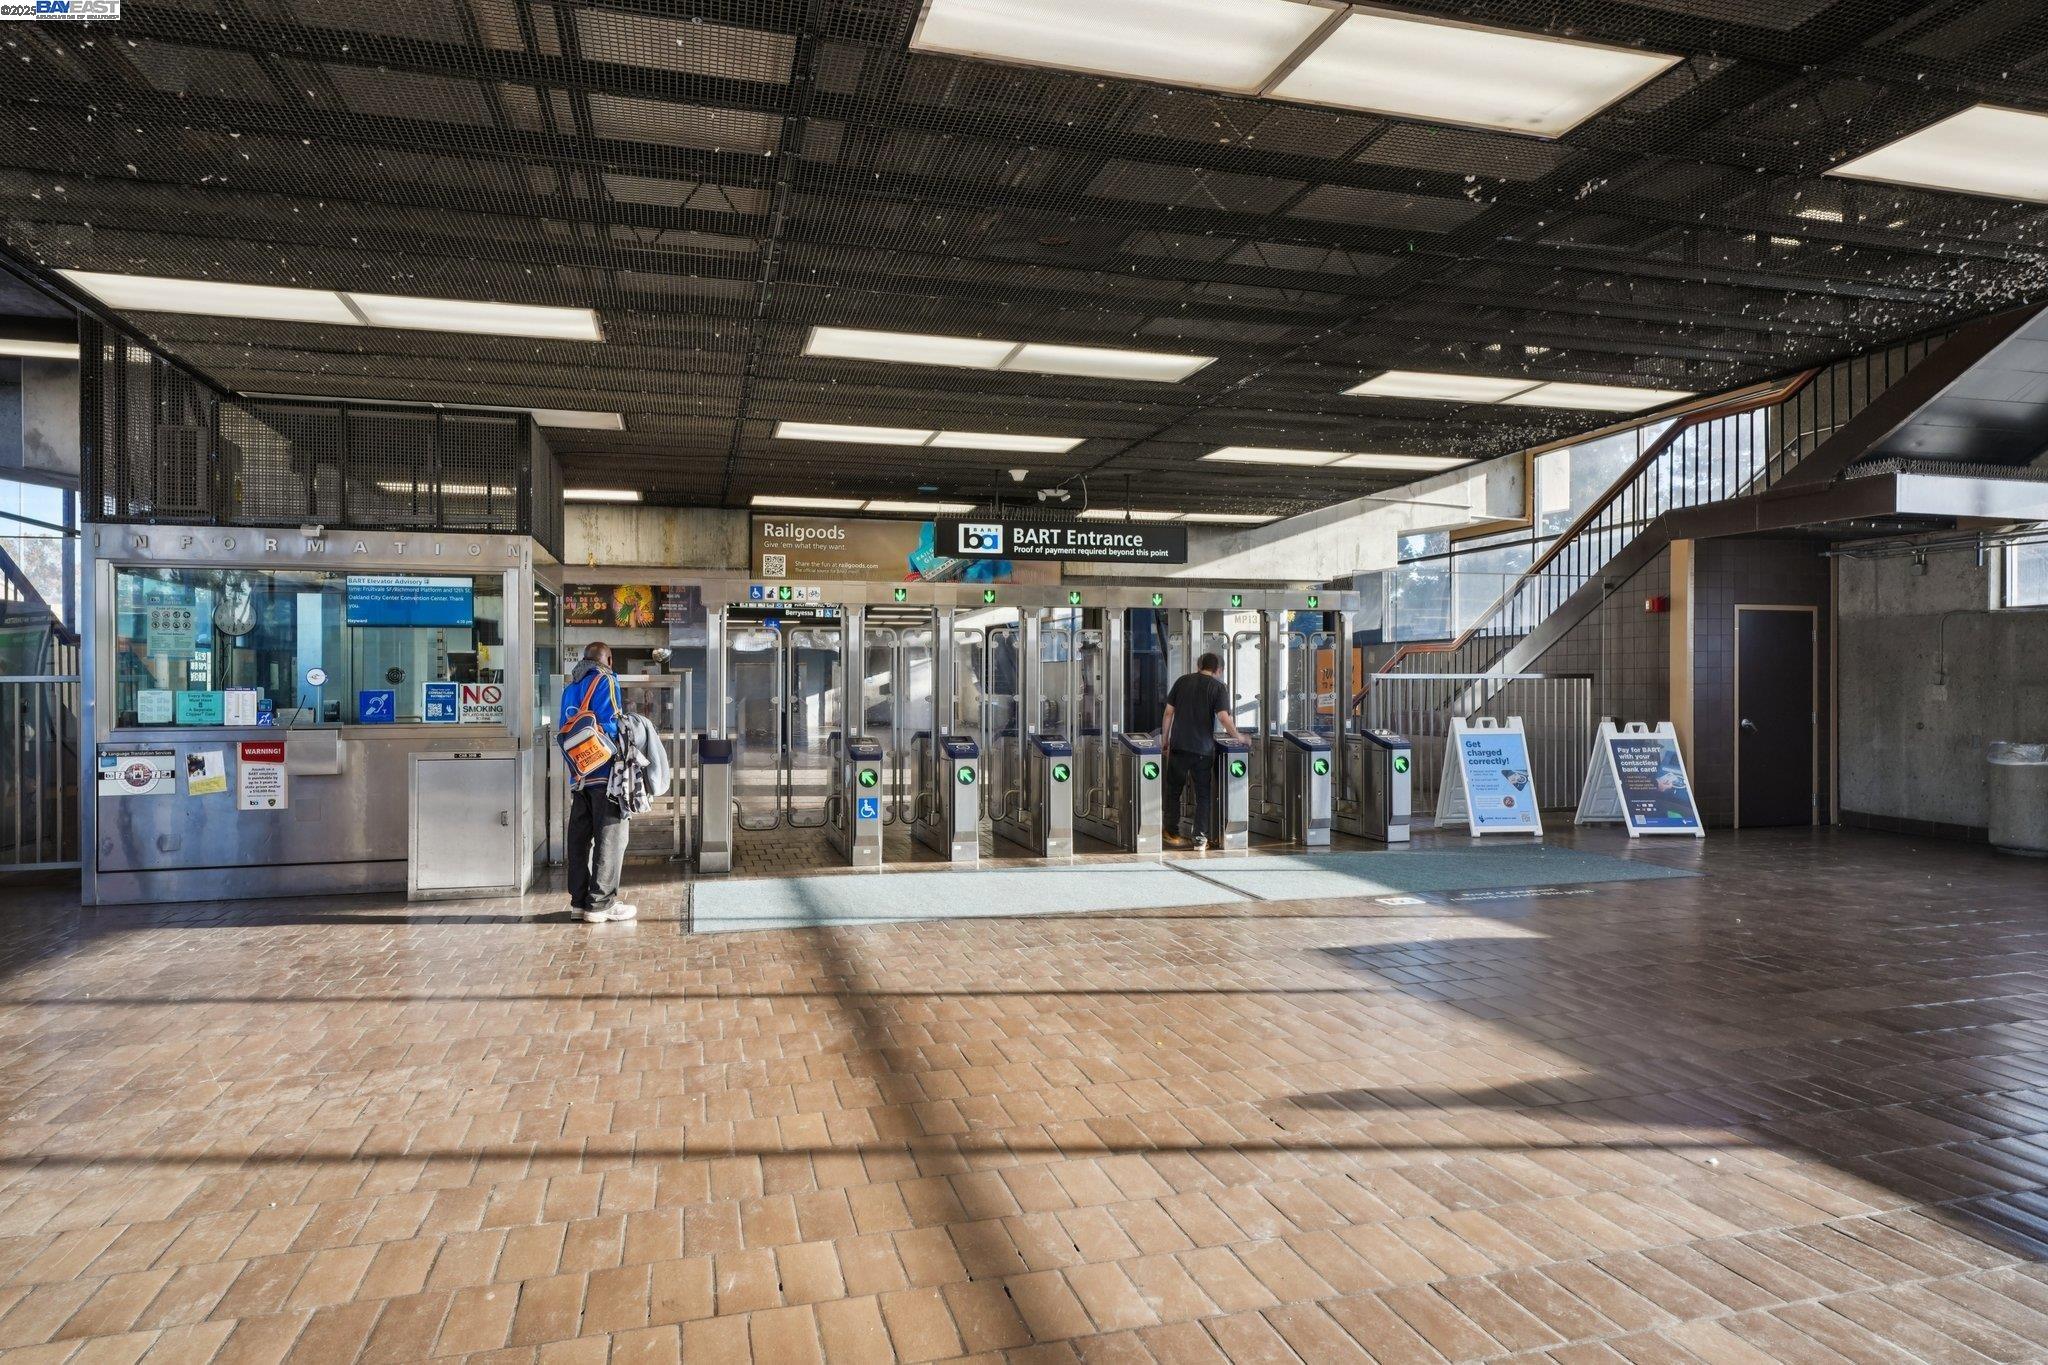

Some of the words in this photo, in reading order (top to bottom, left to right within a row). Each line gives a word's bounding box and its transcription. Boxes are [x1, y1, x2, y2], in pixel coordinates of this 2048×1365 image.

[764, 523, 845, 541] Railgoods
[1013, 528, 1061, 544] BART
[1067, 530, 1143, 546] Entrance
[813, 543, 826, 551] they
[1045, 547, 1076, 555] payment
[1078, 548, 1107, 556] required
[463, 705, 503, 713] SMOKING
[1467, 749, 1502, 757] charged
[1469, 757, 1509, 766] correctly!
